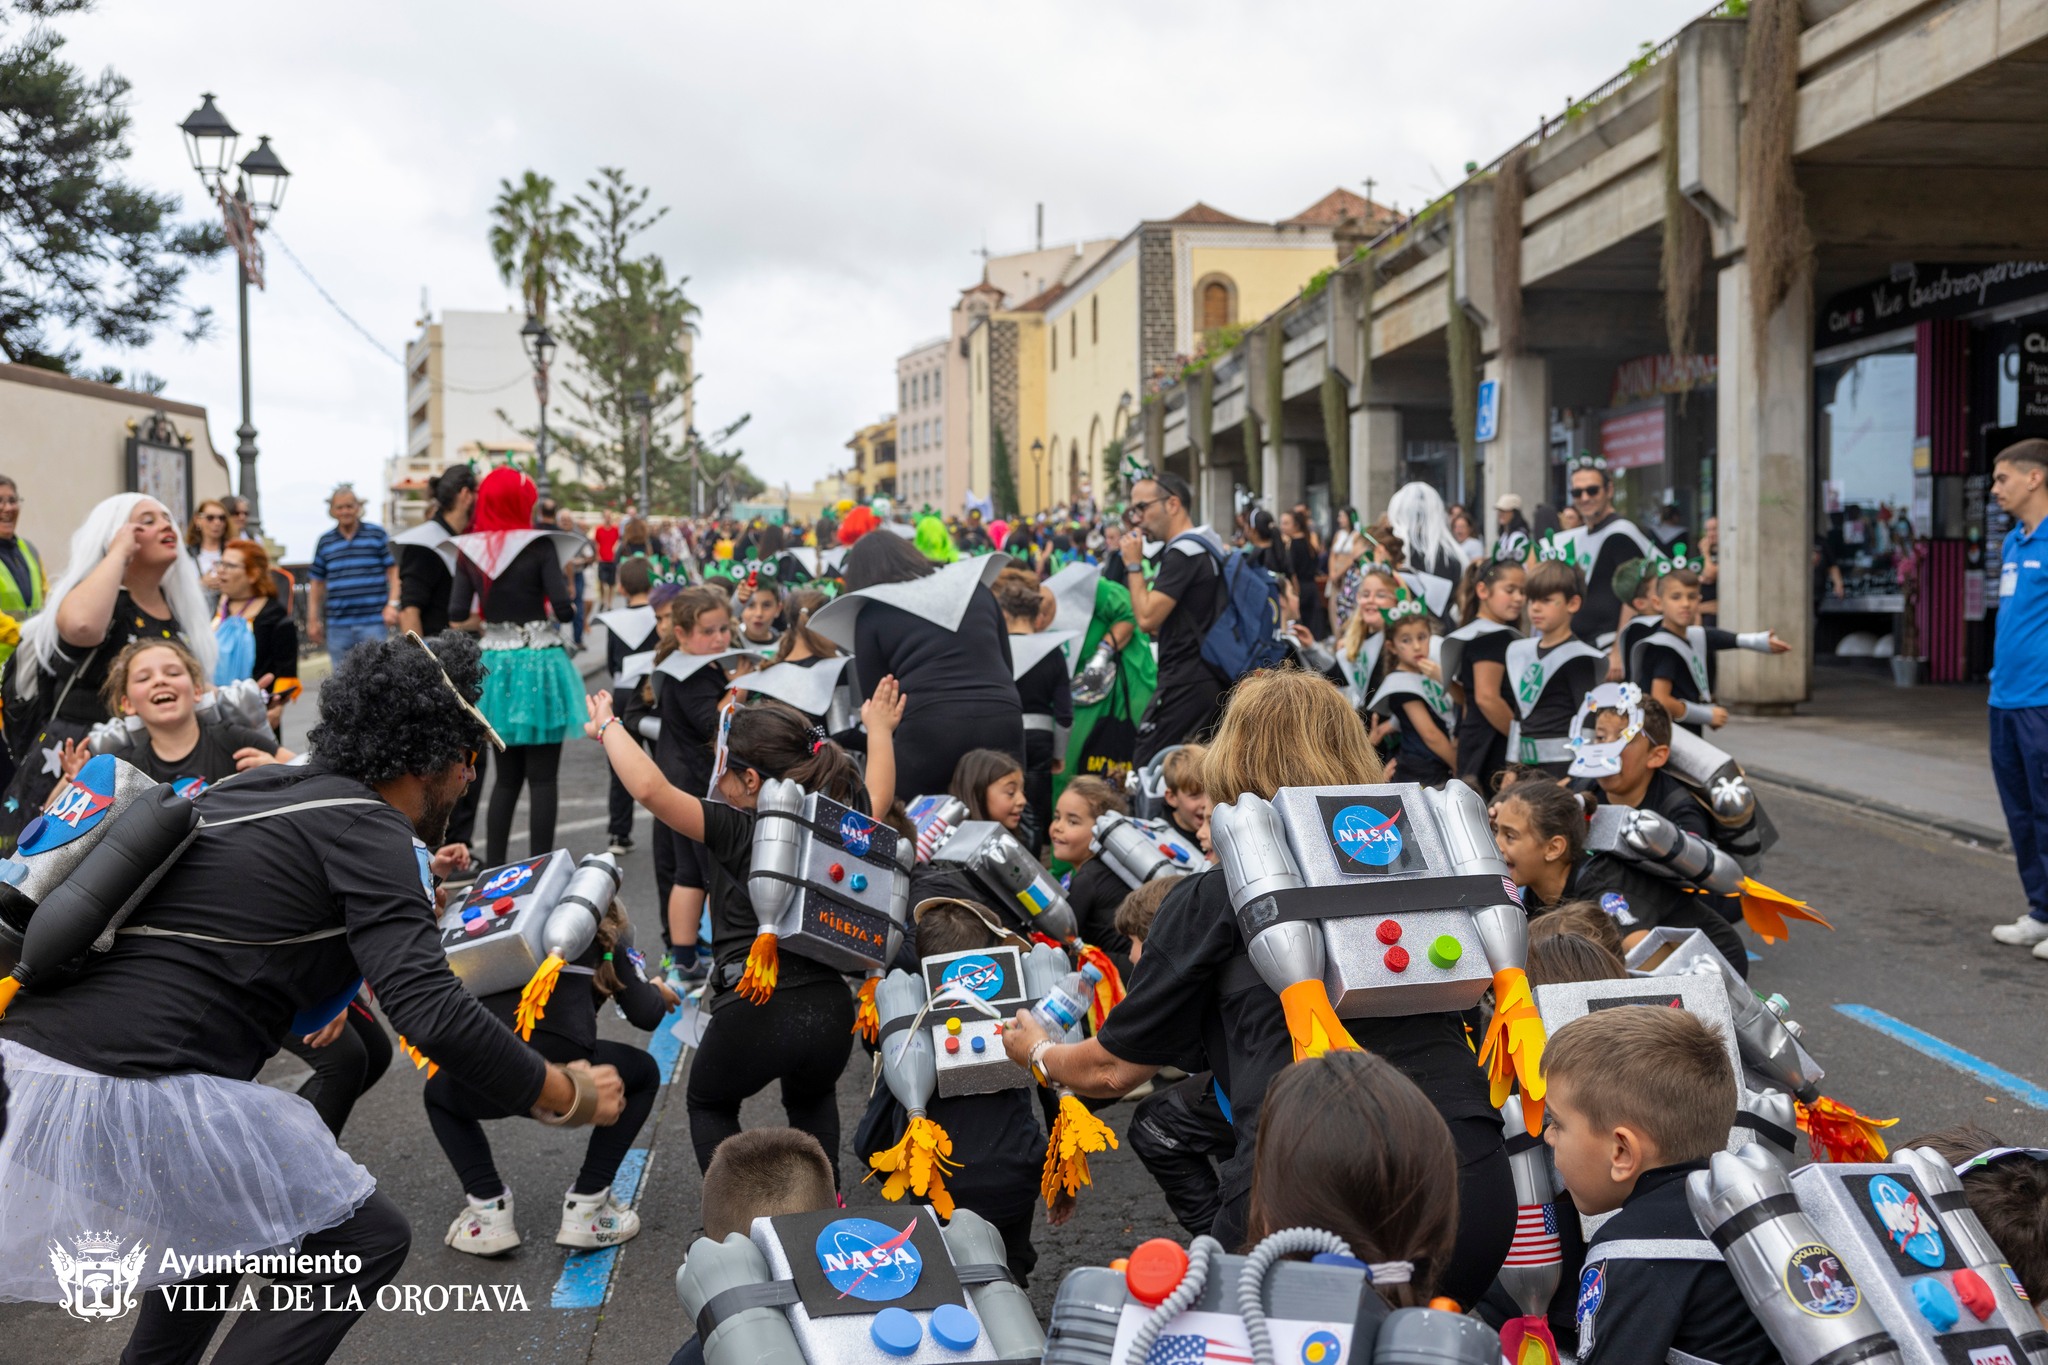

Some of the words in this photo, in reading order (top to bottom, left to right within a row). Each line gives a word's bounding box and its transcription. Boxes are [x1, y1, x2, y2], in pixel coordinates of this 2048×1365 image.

[840, 823, 870, 845] NASA
[1337, 828, 1399, 843] NASA
[823, 1247, 917, 1272] NASA
[1791, 1247, 1821, 1268] APOLLO
